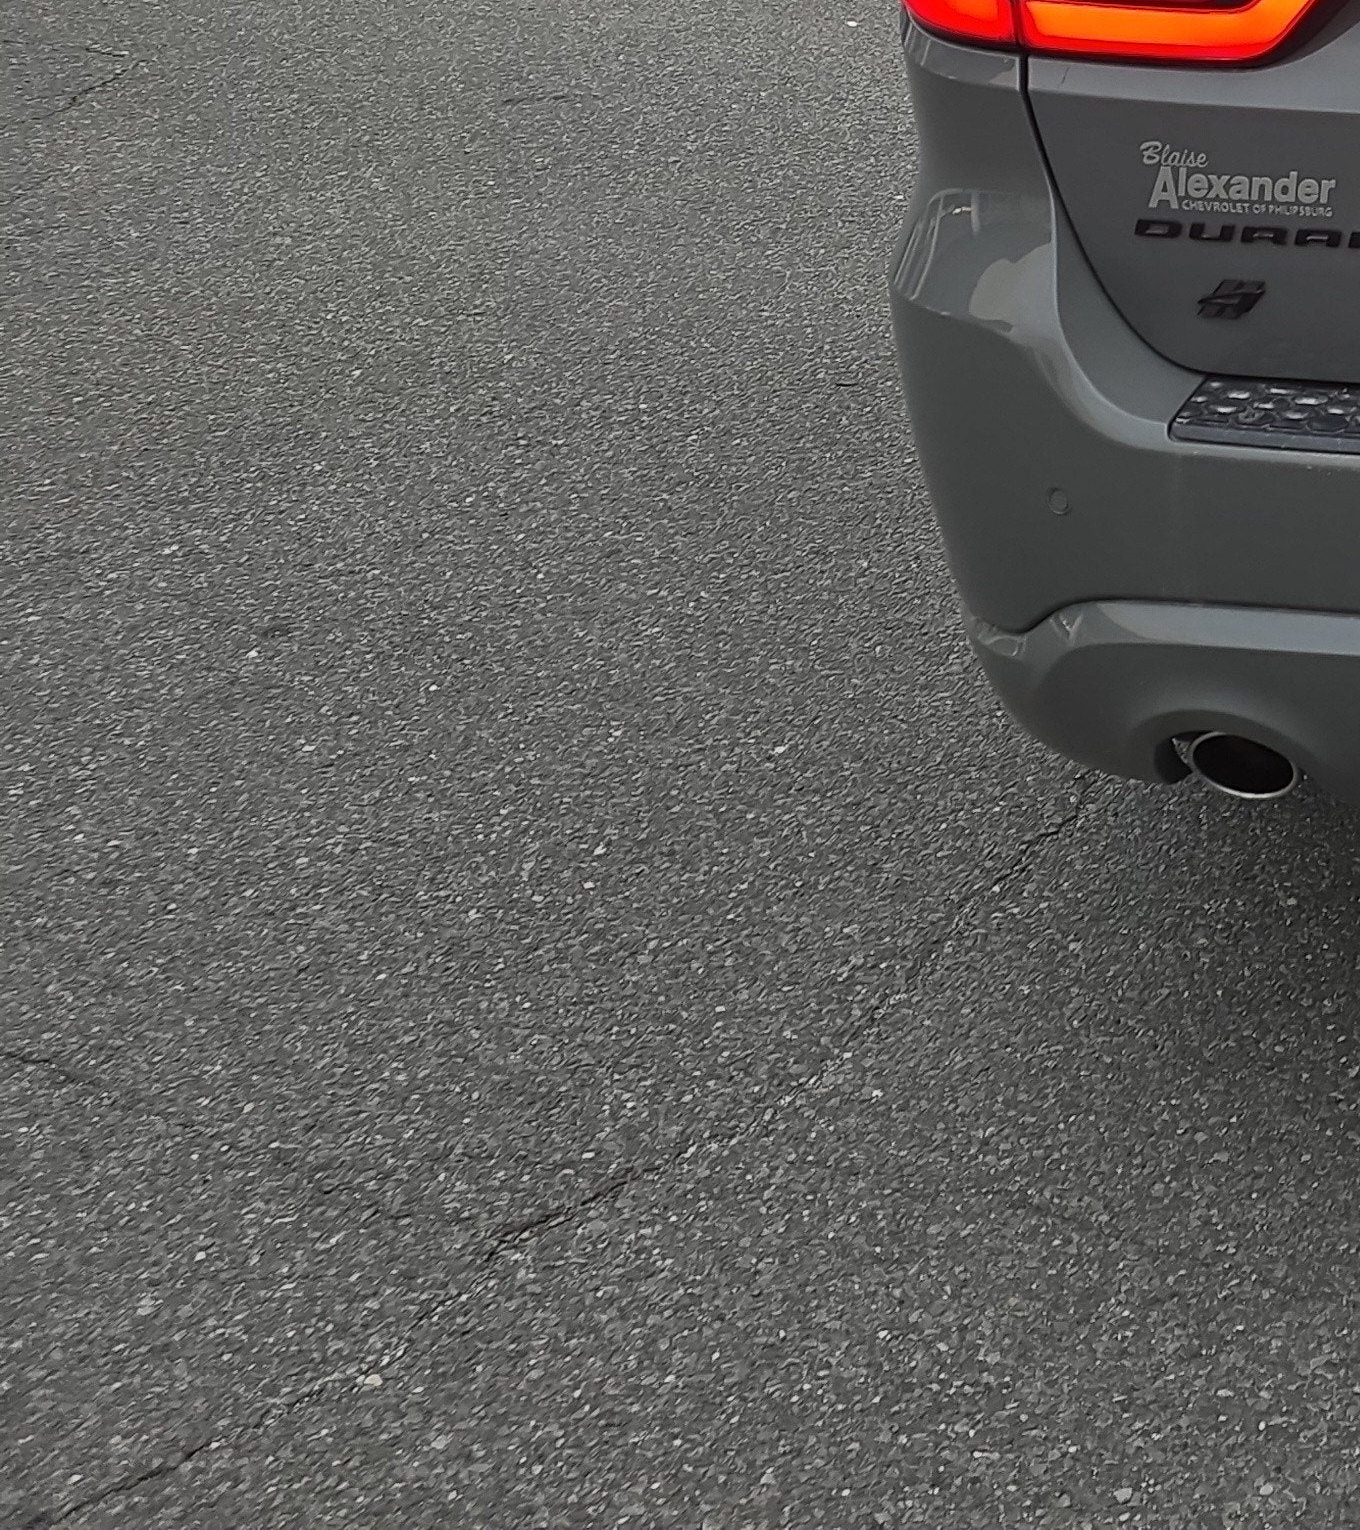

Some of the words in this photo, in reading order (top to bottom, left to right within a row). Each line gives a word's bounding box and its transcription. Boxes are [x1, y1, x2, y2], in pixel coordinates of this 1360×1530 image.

[1139, 140, 1209, 168] Blaise
[1148, 166, 1336, 210] Alexander
[1181, 199, 1250, 213] CHEVROLET
[1252, 204, 1267, 215] OF
